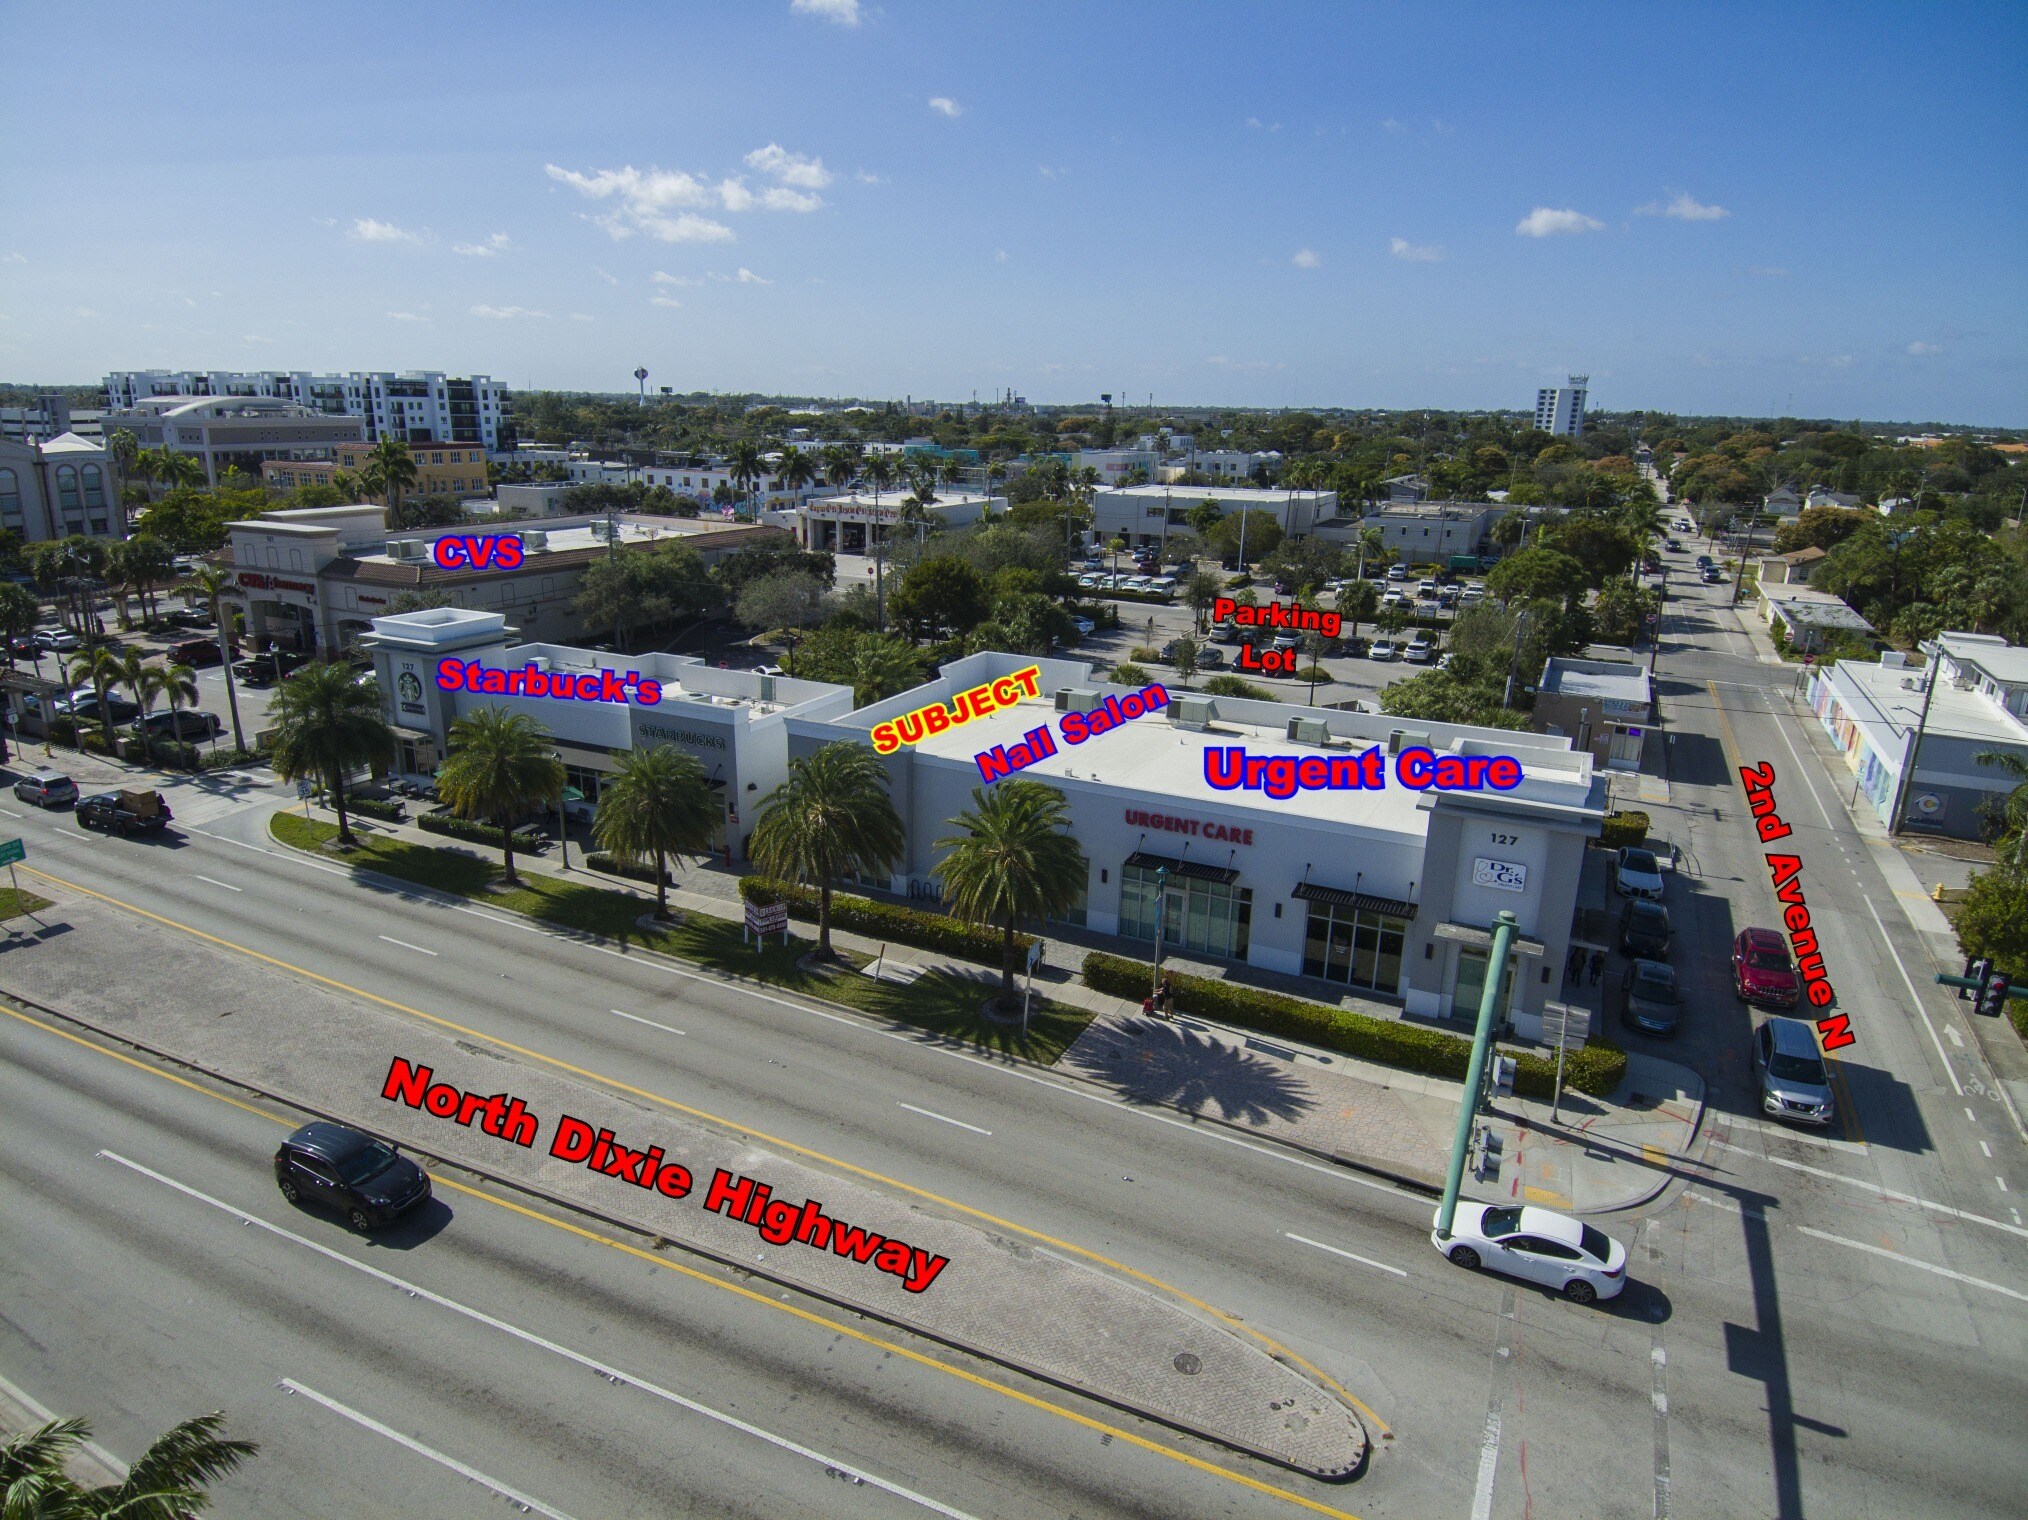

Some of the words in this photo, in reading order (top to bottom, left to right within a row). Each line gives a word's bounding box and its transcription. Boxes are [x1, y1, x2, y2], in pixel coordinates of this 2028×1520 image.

[402, 662, 415, 670] 127
[638, 725, 725, 750] STARBUCKS
[300, 788, 310, 796] 35
[1125, 809, 1200, 836] URGENT
[1202, 822, 1253, 846] CARE
[1491, 833, 1519, 846] 127
[1490, 862, 1514, 874] Dr.
